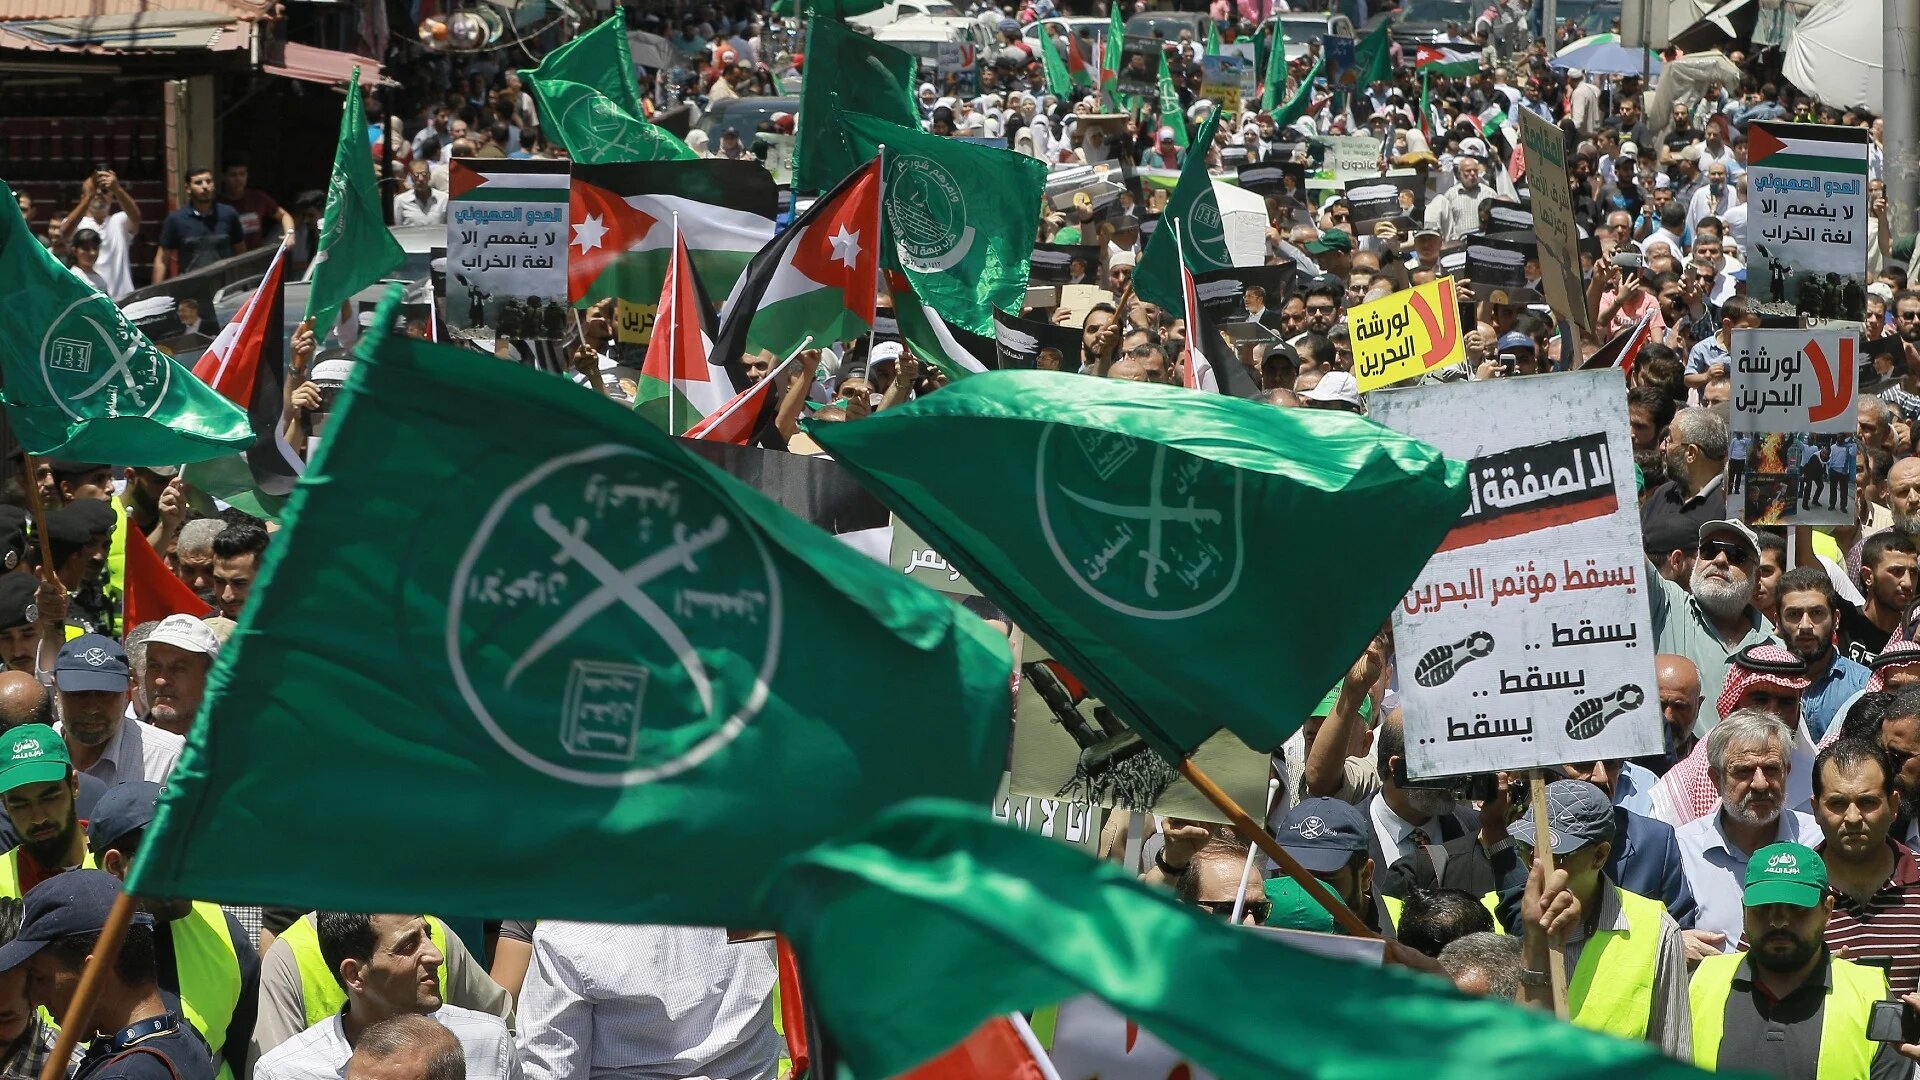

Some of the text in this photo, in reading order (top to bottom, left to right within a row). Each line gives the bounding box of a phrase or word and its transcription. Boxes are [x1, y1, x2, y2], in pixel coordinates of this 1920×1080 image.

[1755, 173, 1860, 198] العدو الصهيوني
[455, 206, 562, 226] العدو الصهيوني
[1762, 199, 1854, 221] لا يفهم إلا
[462, 231, 556, 249] لا يفهم إلا
[1762, 226, 1851, 244] لغة الخراب
[461, 254, 553, 272] لغة الخراب
[920, 245, 942, 256] جبهة
[1356, 305, 1410, 341] لورشة
[1408, 279, 1457, 369] لا
[1360, 335, 1415, 377] البحرين
[1738, 346, 1801, 381] لورشة
[1803, 337, 1854, 423] لا
[1735, 383, 1802, 414] البحرين
[1482, 448, 1586, 509] لصفقة
[1590, 443, 1611, 488] لا
[1083, 521, 1135, 582] المسلمون
[1402, 560, 1637, 615] يسقط مؤتمر البحرين
[1552, 619, 1637, 649] يسقط
[1499, 666, 1585, 695] يسقط
[1447, 713, 1533, 743] يسقط
